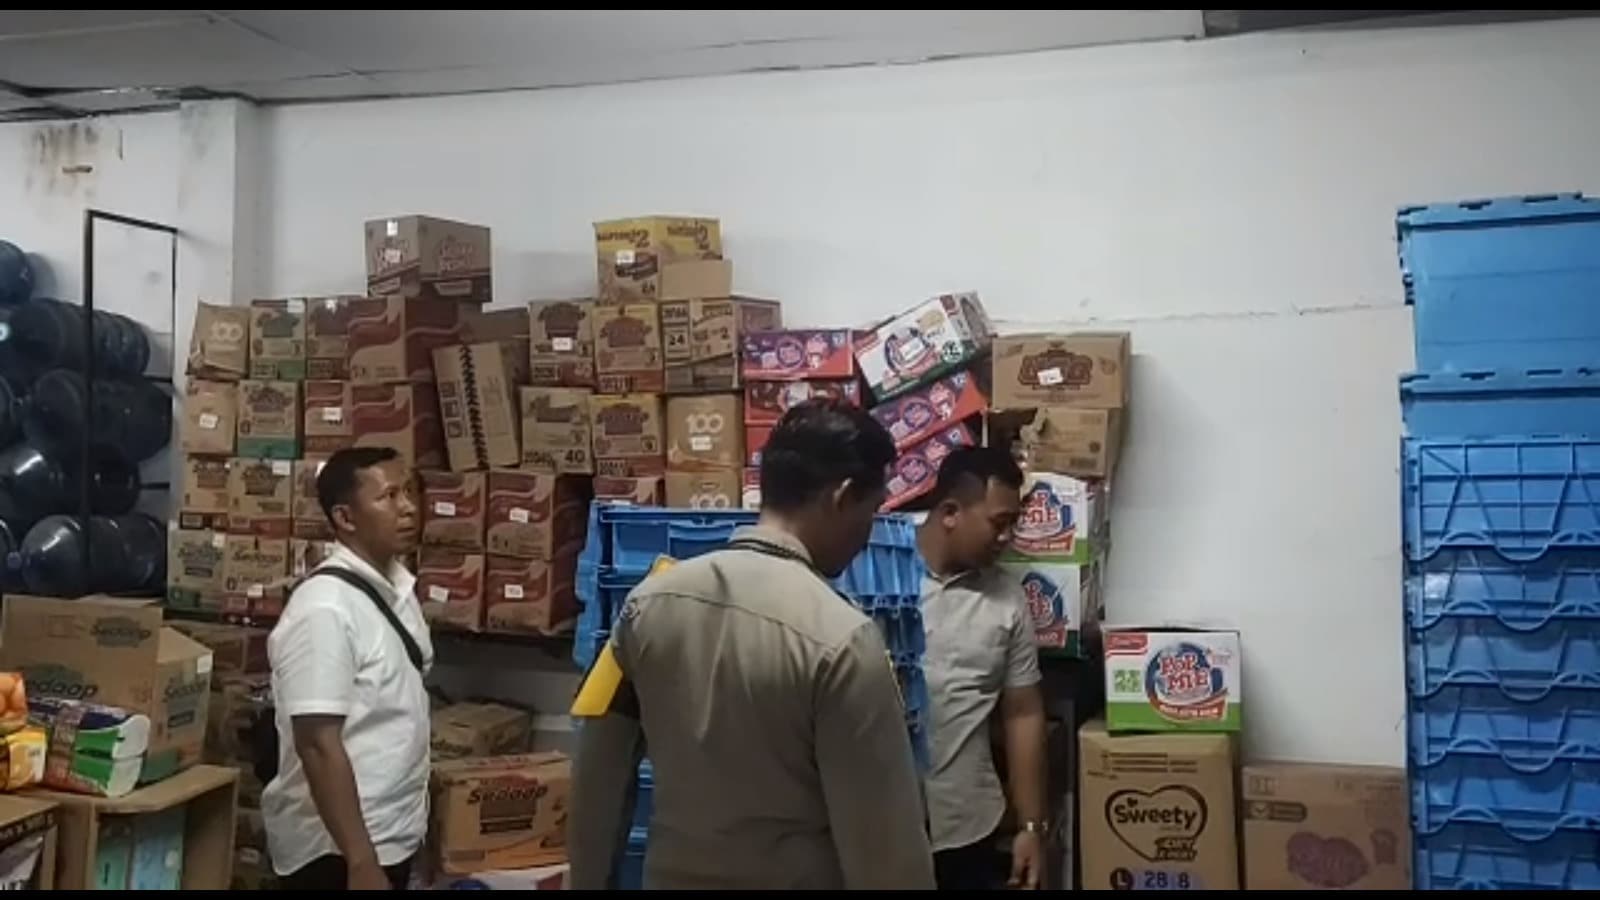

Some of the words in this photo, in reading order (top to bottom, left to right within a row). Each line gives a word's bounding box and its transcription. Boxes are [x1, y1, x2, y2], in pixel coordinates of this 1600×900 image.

[685, 412, 724, 434] 100
[564, 449, 585, 464] 40
[1113, 803, 1199, 831] Sweety
[1143, 870, 1168, 889] 28
[1178, 871, 1190, 889] 8
